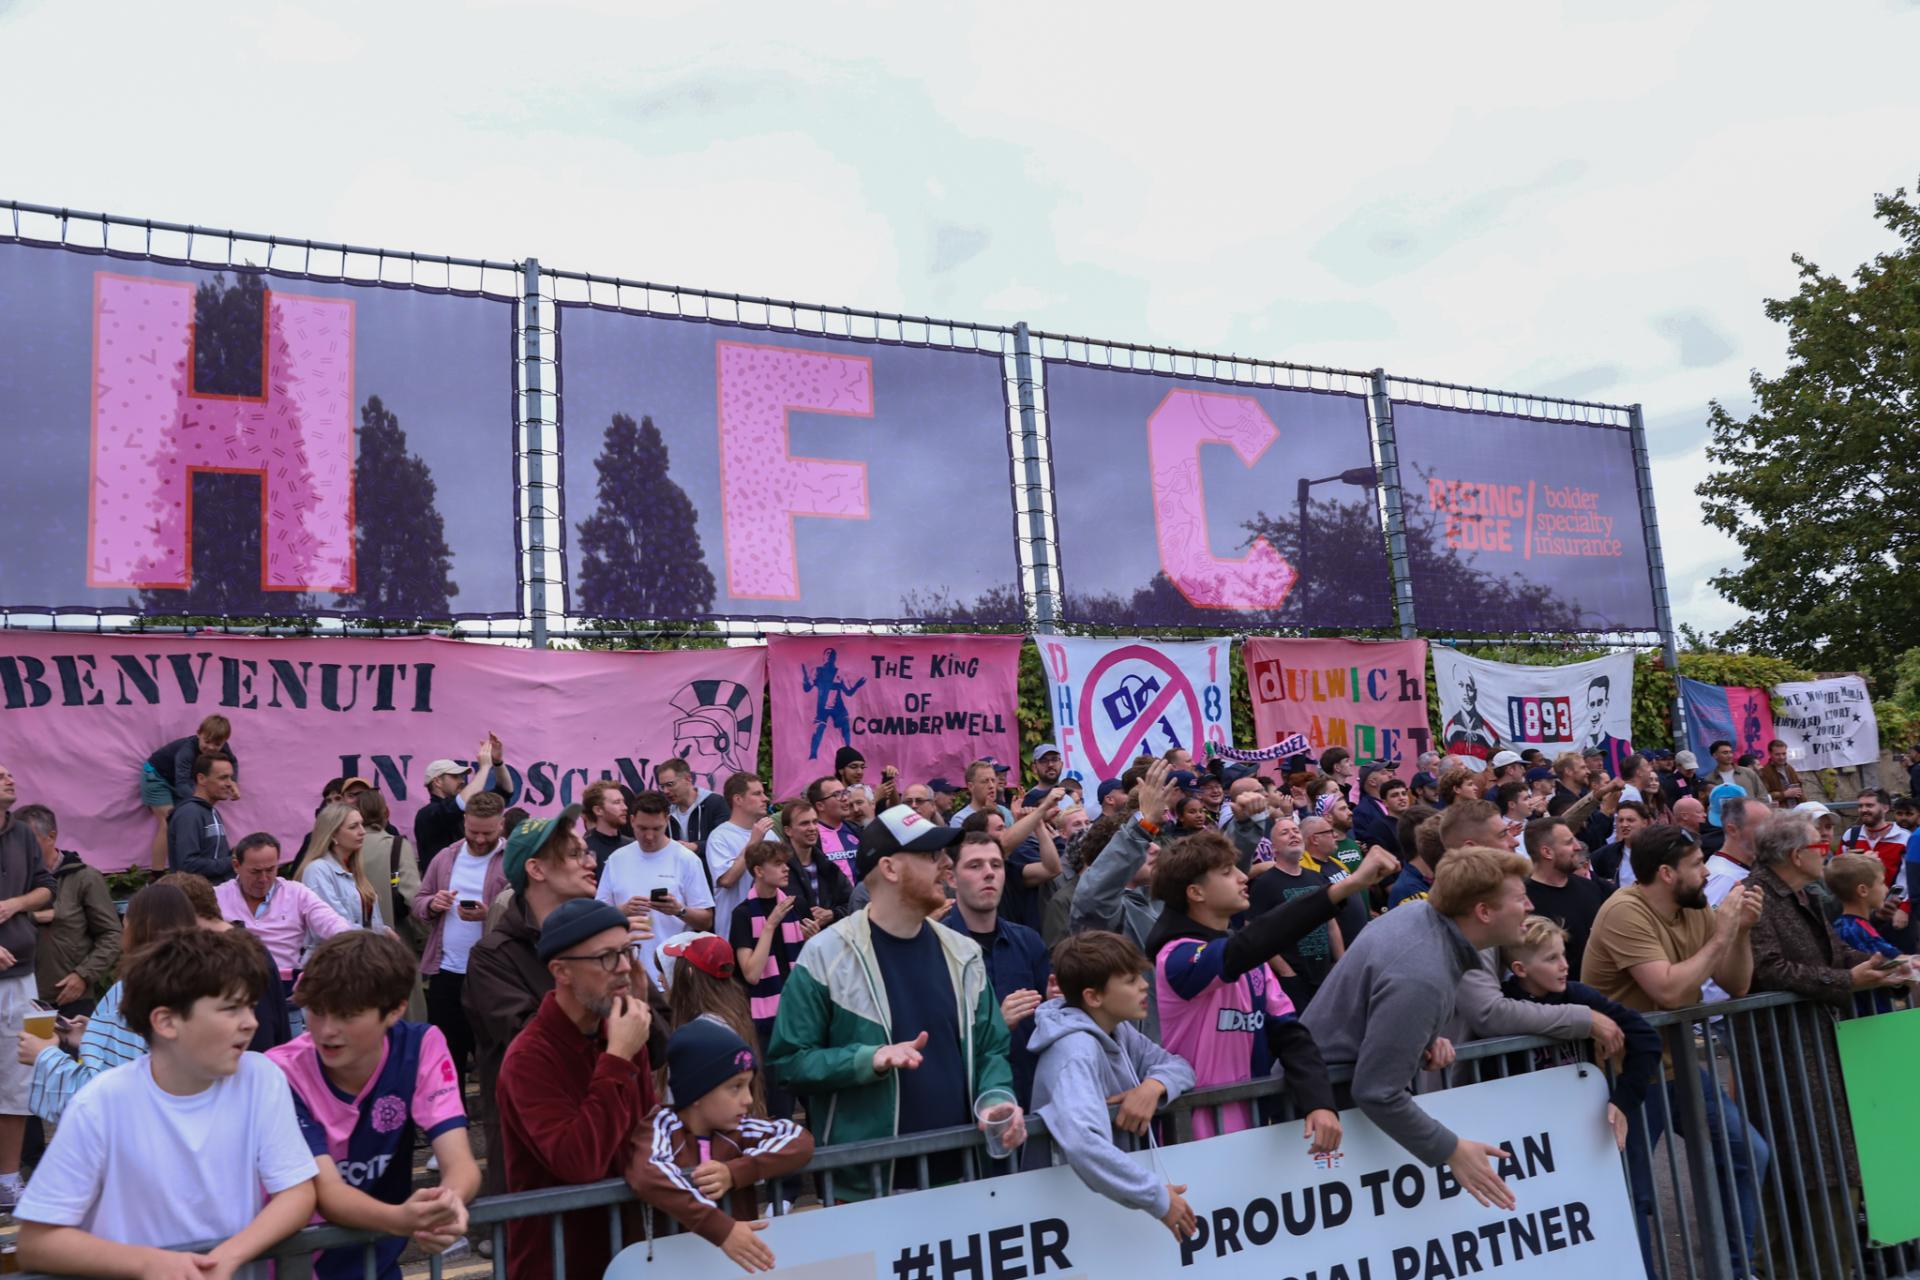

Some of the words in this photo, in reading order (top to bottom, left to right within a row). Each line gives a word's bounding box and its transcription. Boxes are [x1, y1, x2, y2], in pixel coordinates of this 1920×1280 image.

[87, 271, 357, 593] H
[716, 340, 874, 600] F
[1146, 387, 1298, 611] C
[1428, 478, 1525, 518] RISING
[1543, 485, 1599, 511] bolder
[1446, 515, 1513, 552] EDGE
[1536, 511, 1614, 537] specialty
[1535, 531, 1623, 557] insurance
[0, 652, 436, 713] BENVENUTI
[871, 655, 914, 680] THE
[904, 692, 932, 713] OF
[1511, 701, 1570, 737] 1893
[1181, 1180, 1353, 1267] PROUD
[1360, 1163, 1426, 1217] TO
[892, 1217, 1074, 1280] #HER
[1392, 1201, 1596, 1280] PARTNER
